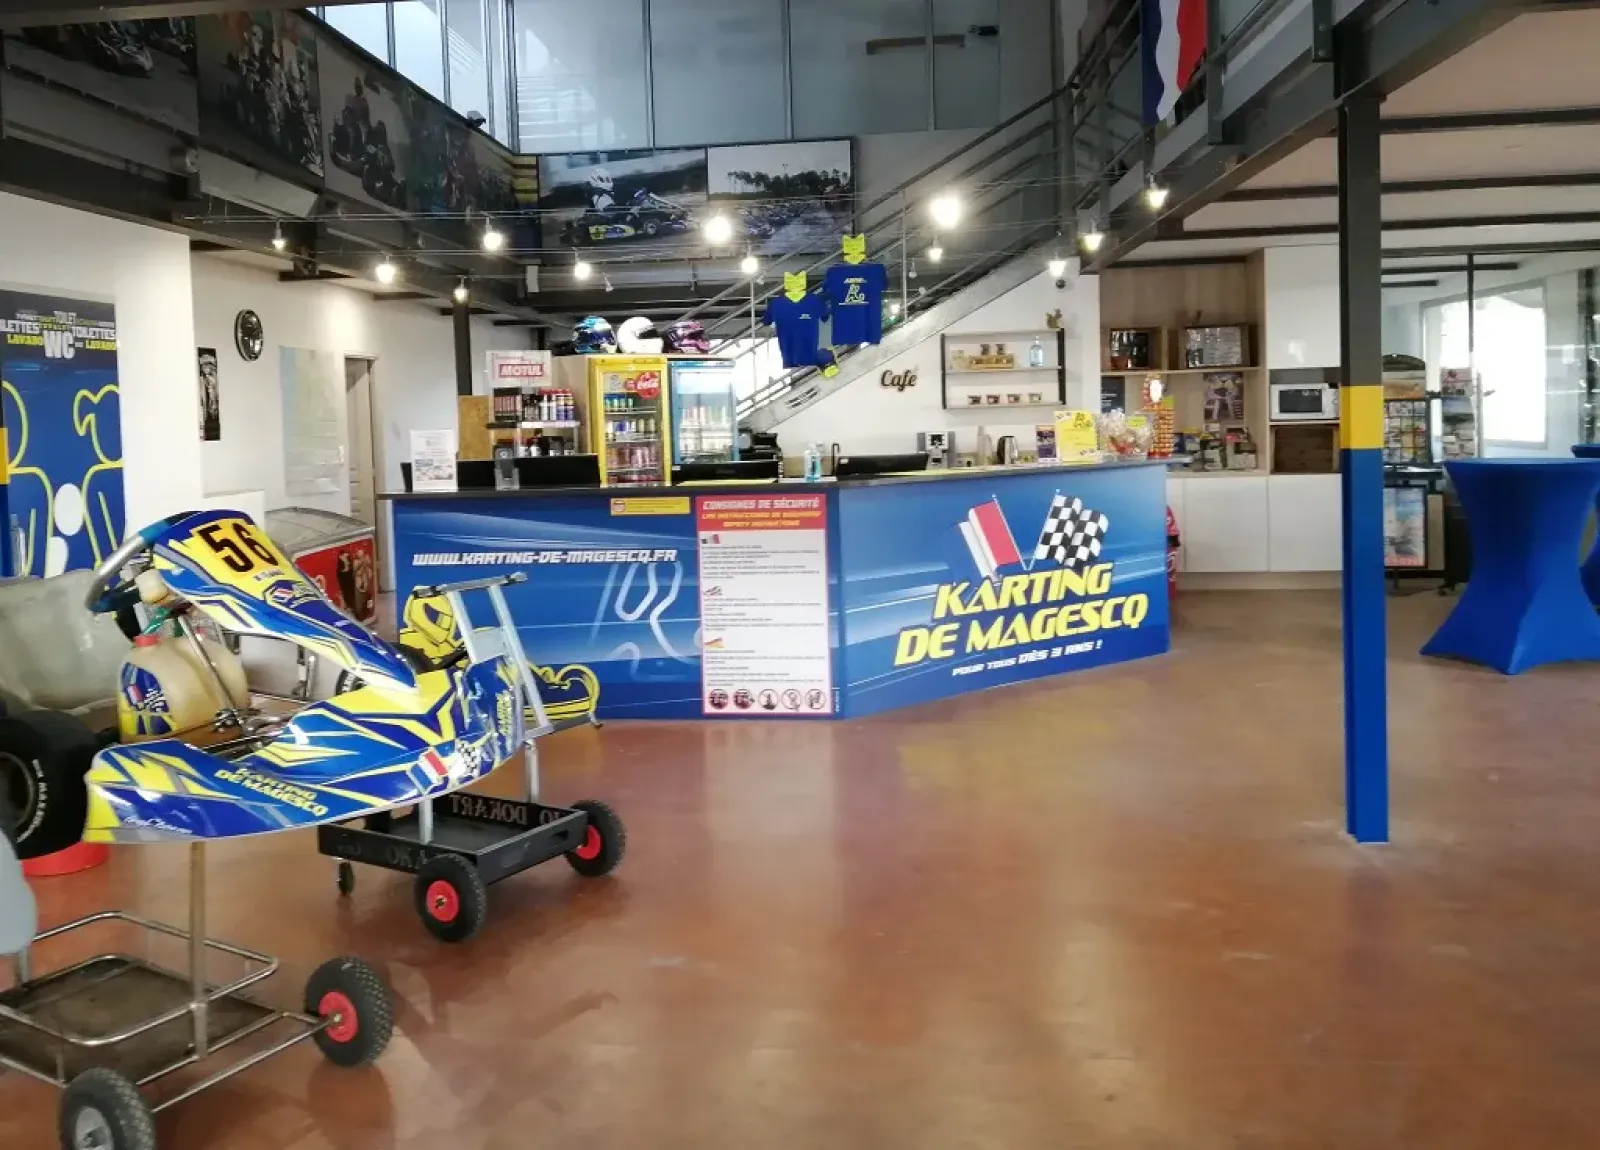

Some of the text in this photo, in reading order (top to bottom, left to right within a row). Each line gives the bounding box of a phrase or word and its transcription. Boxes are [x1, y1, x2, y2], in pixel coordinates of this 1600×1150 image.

[43, 330, 75, 359] WC
[500, 364, 543, 377] MOTUL
[757, 500, 772, 509] DE
[197, 523, 279, 573] 56
[412, 550, 678, 566] WWW.KARTING-DE-MAGESCQ.FR
[932, 562, 1114, 619] KARTING
[894, 593, 1150, 666] DE MAGESCQ
[952, 662, 985, 676] POUR
[987, 656, 1017, 670] TOUS
[1051, 646, 1065, 658] 3
[1064, 642, 1095, 656] ANS
